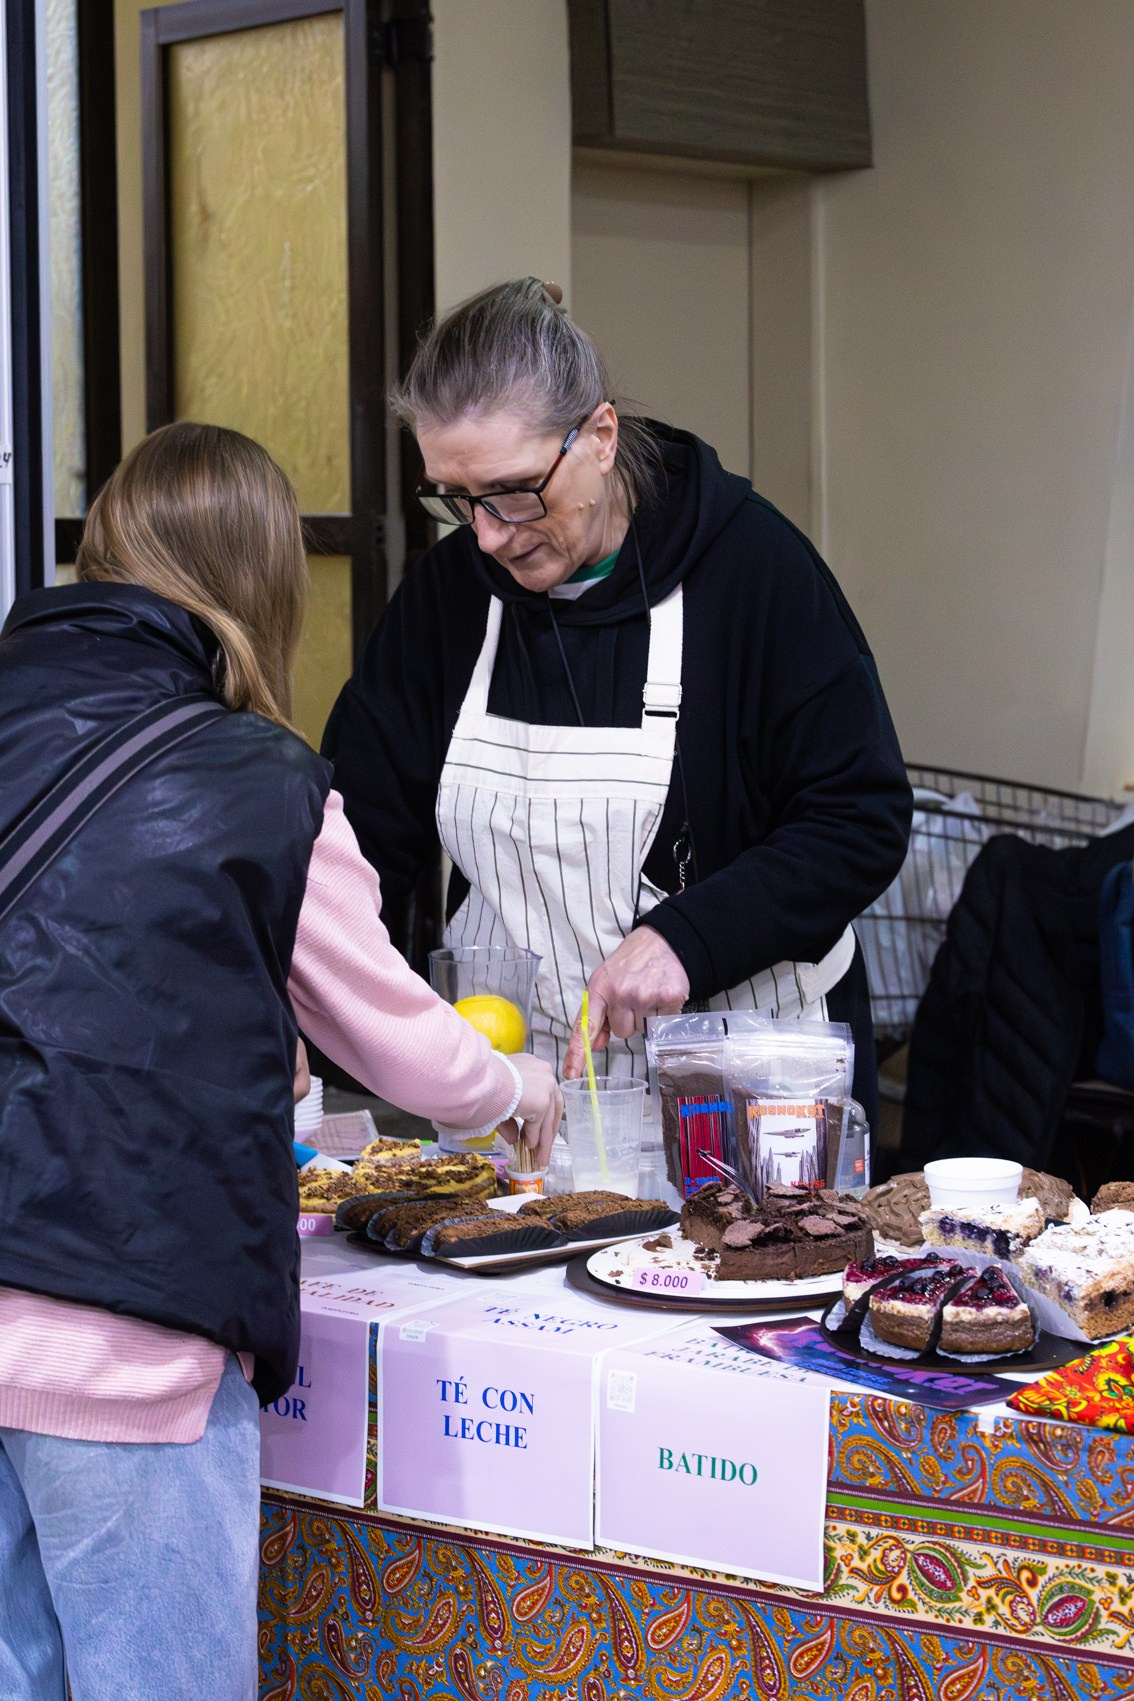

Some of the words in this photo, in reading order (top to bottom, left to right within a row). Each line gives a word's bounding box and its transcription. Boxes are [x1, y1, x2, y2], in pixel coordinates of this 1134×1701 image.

[299, 1218, 316, 1231] 00
[639, 1272, 648, 1286] $
[651, 1273, 688, 1289] 8.000
[300, 1288, 395, 1309] ALIDAD
[482, 1317, 574, 1335] ASSAM
[524, 1312, 618, 1330] NEGRO
[643, 1350, 808, 1383] FRAMBUESA
[671, 1346, 772, 1367] JARABE
[436, 1376, 468, 1405] TÉ
[482, 1386, 535, 1415] CON
[262, 1395, 308, 1421] OR
[443, 1414, 529, 1450] LECHE
[657, 1446, 759, 1486] BATIDO
